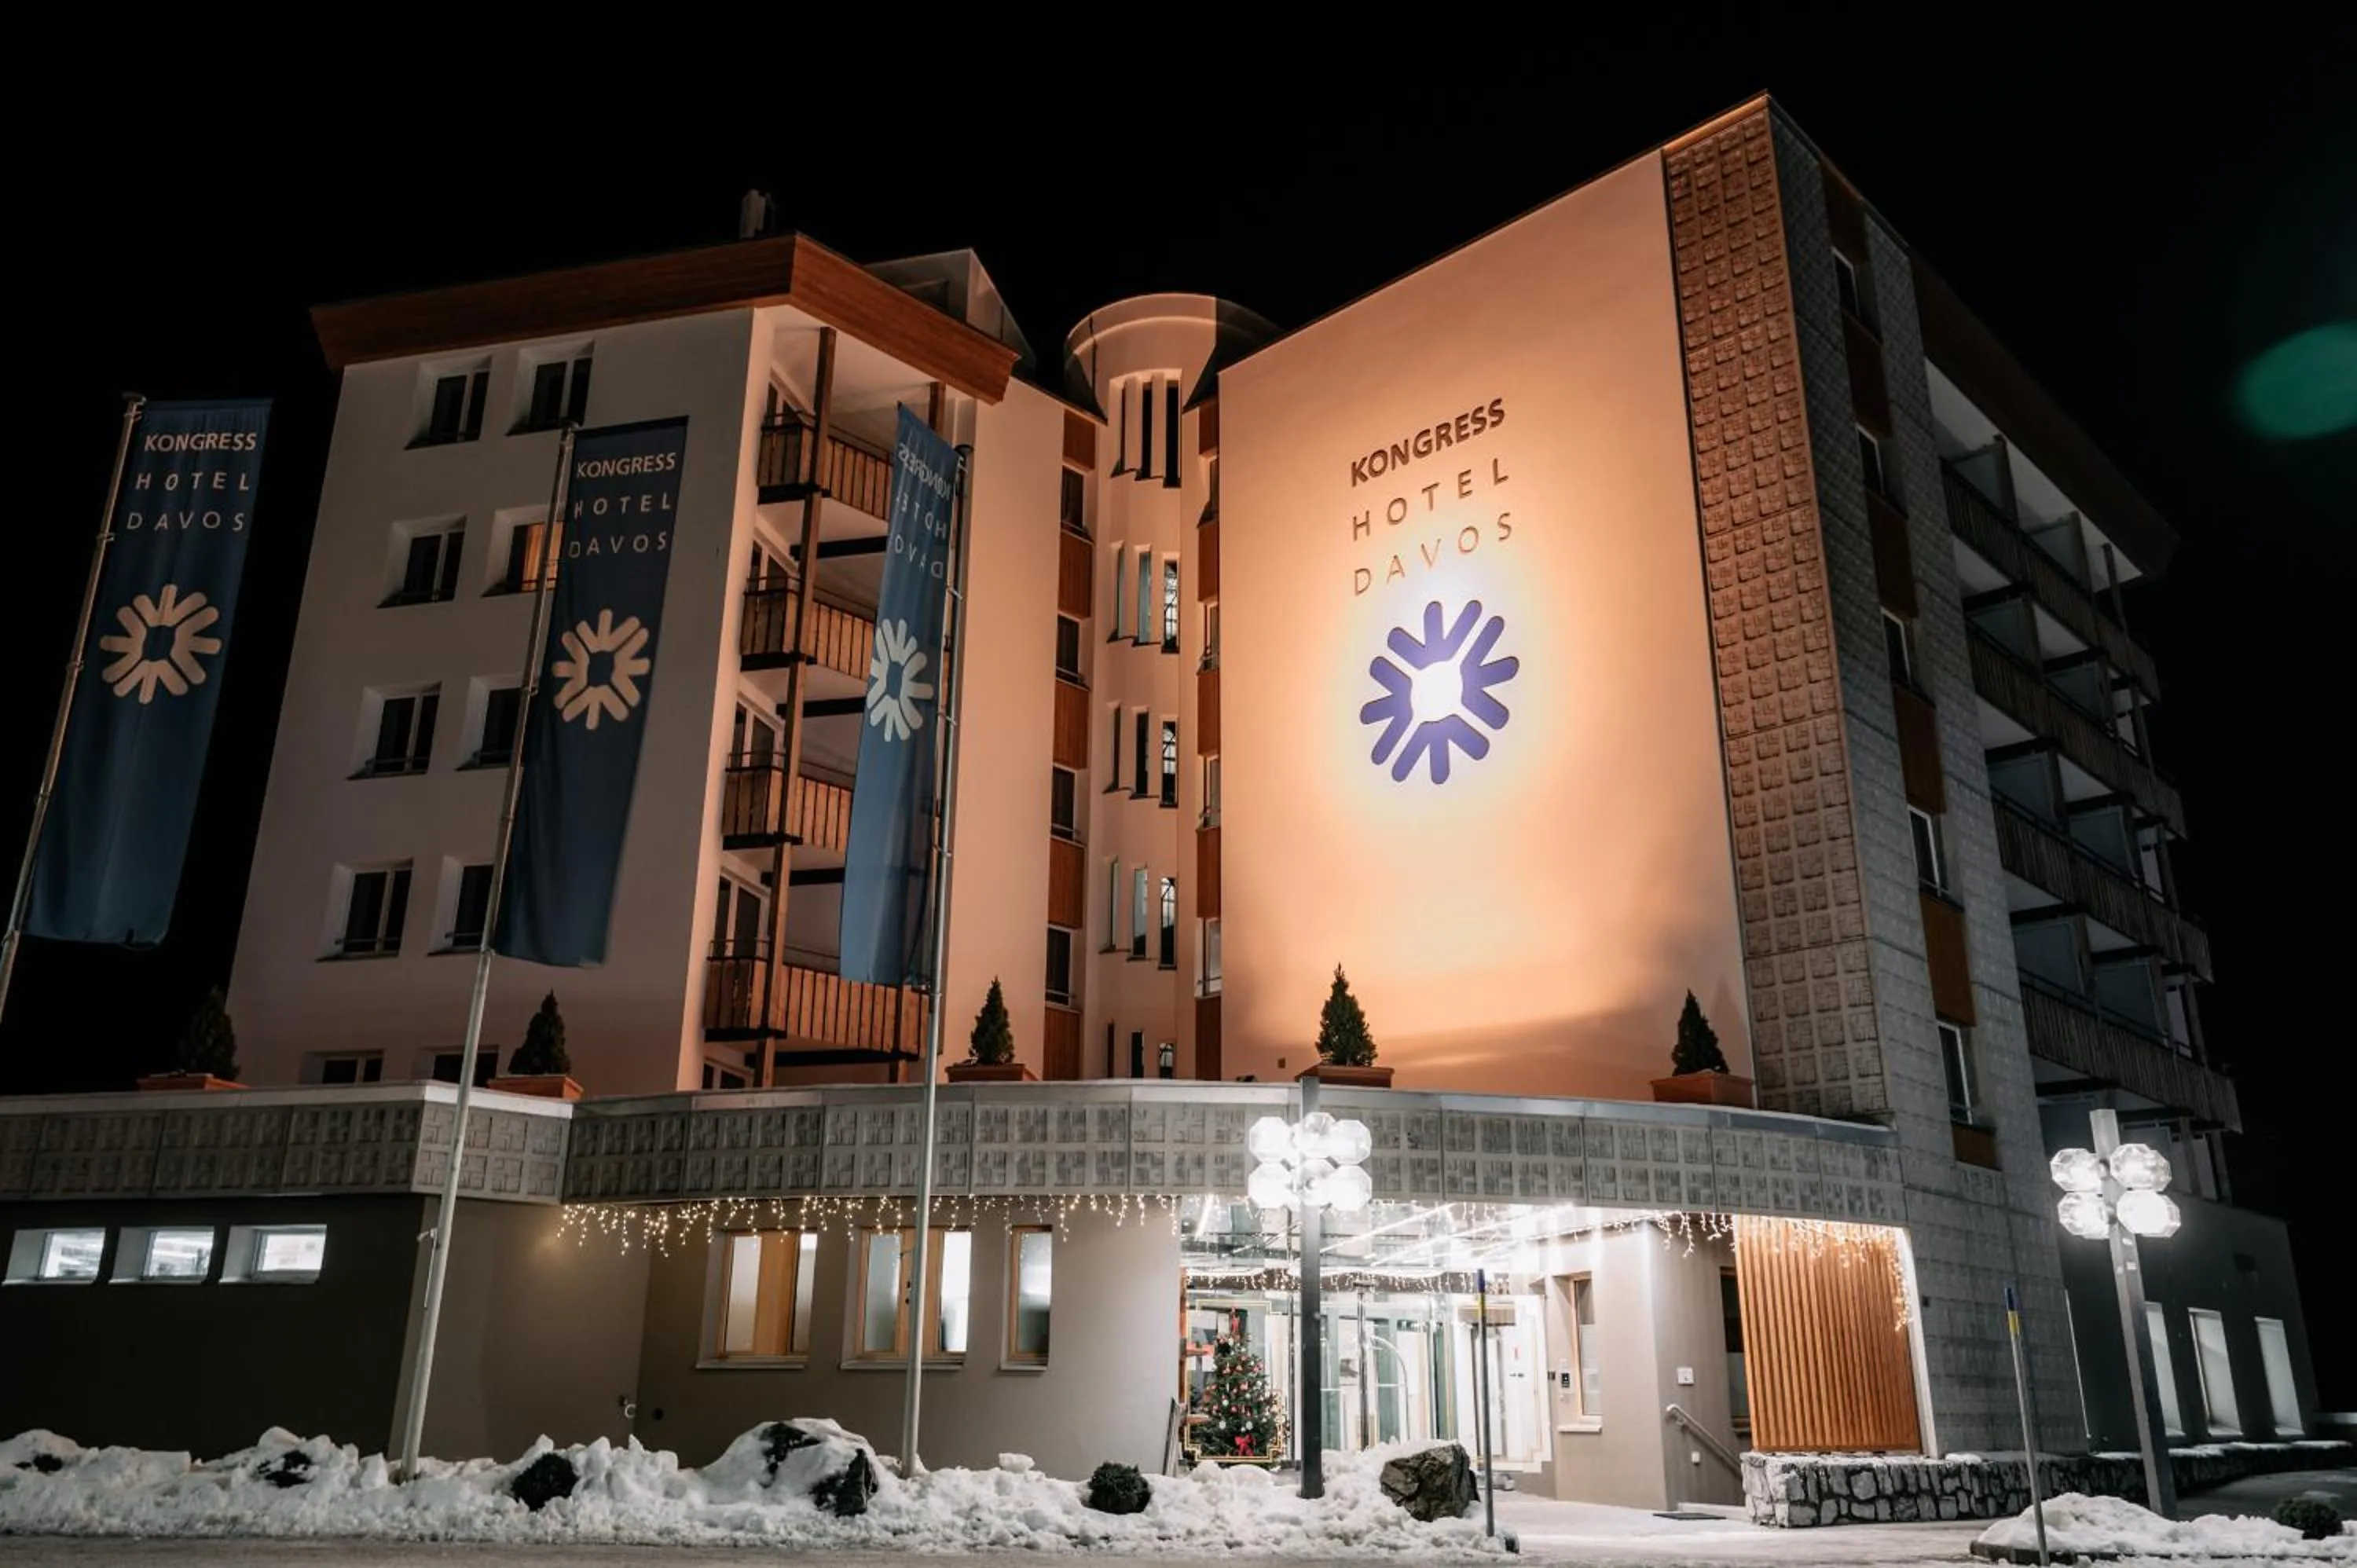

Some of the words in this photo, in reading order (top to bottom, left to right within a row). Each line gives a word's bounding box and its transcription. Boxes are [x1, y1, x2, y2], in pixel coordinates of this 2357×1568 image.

[144, 432, 257, 452] KONGRESS
[1350, 397, 1505, 488] KONGRESS
[576, 452, 676, 479] KONGRESS
[135, 471, 251, 491] HOTEL
[574, 492, 671, 520] HOTEL
[1352, 457, 1509, 541] HOTEL
[126, 511, 245, 531] DAVOS
[568, 531, 667, 559] DAVOS
[1354, 511, 1512, 596] DAVOS
